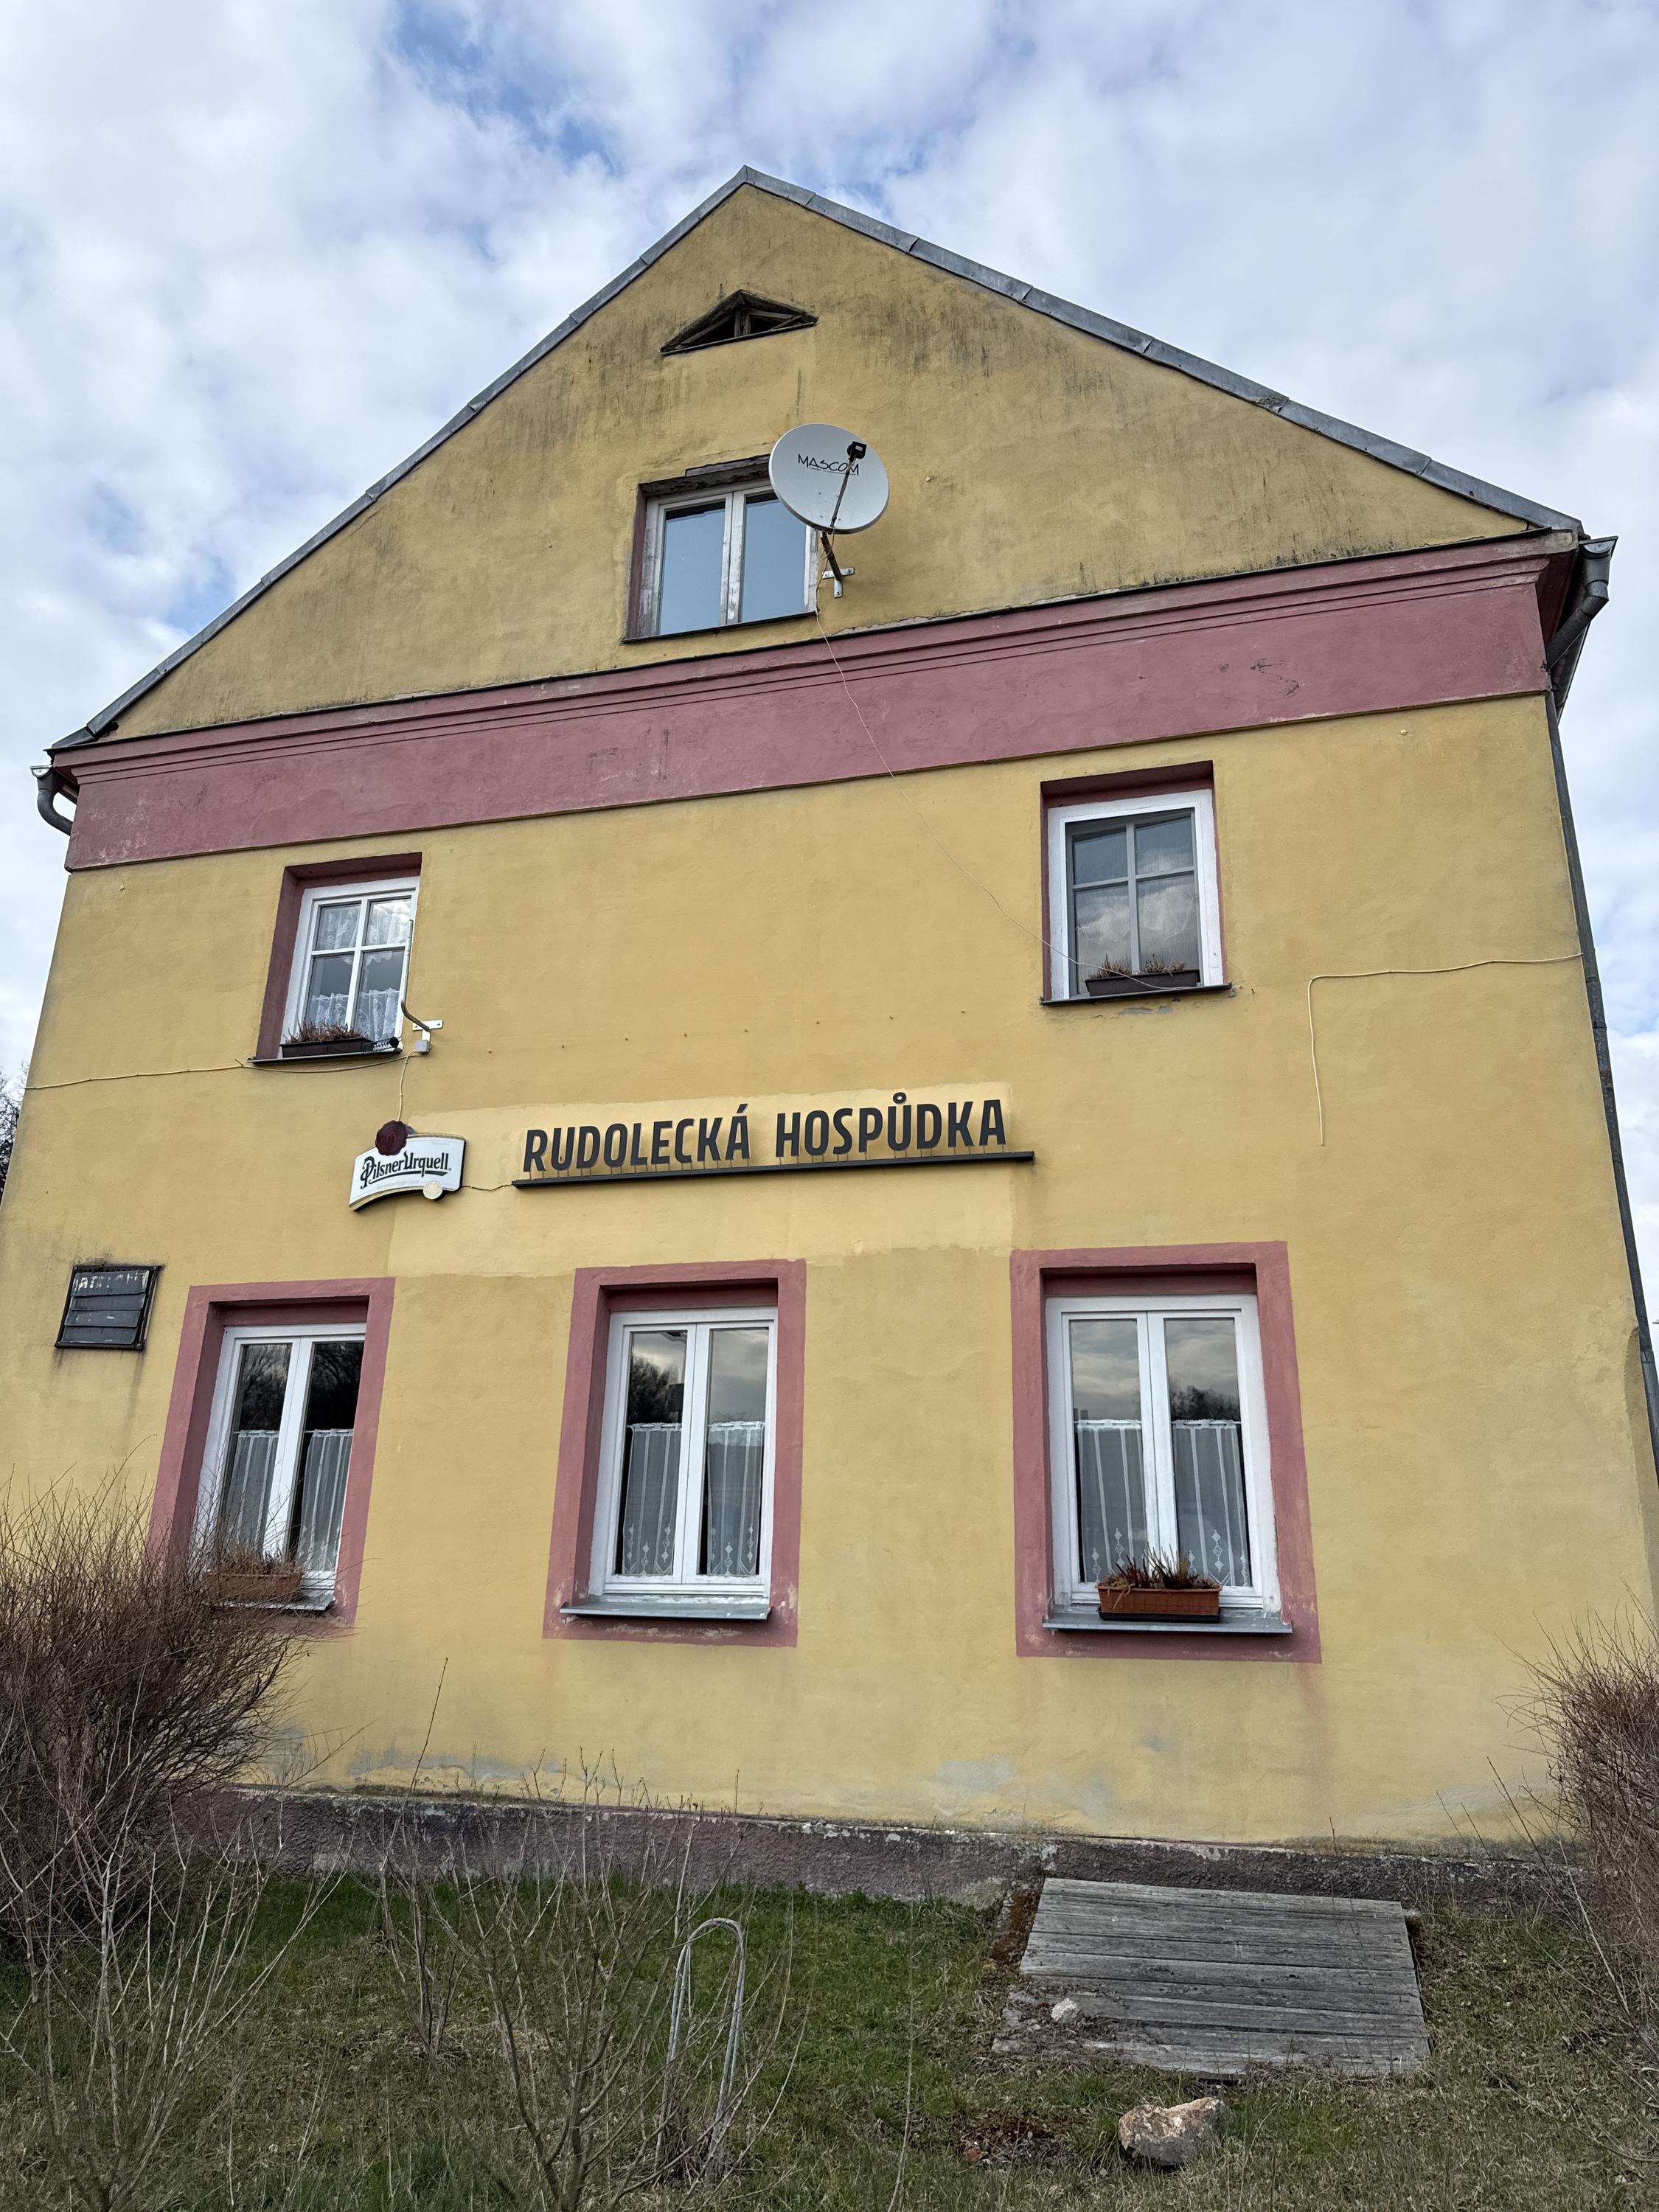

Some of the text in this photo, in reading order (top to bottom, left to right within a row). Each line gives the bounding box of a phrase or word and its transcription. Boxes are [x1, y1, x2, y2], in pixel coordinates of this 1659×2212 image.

[798, 453, 859, 475] MASCOM
[524, 1092, 1006, 1172] RUDOLECKÁ HOSPŮDKA
[360, 1150, 448, 1189] Pilsner Urquell
